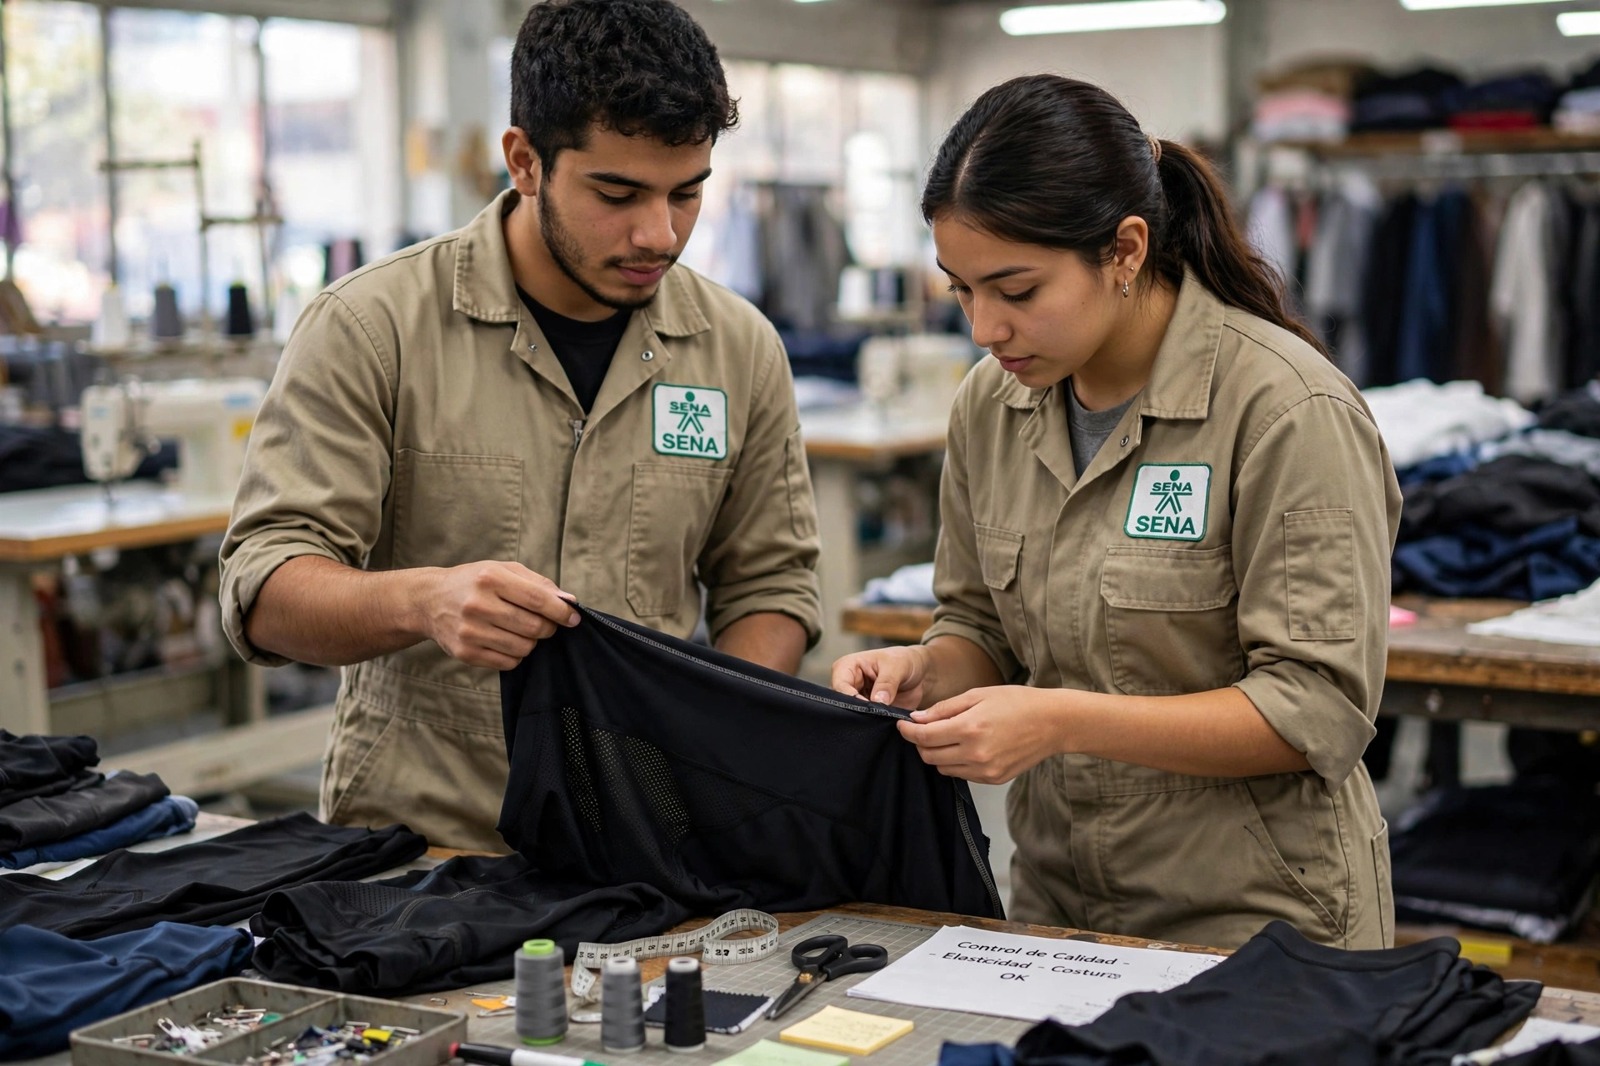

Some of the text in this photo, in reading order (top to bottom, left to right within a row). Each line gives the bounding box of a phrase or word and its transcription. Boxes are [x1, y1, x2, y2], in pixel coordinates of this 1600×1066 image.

[670, 401, 711, 414] SENA
[662, 433, 719, 454] SENA
[1151, 482, 1193, 492] SENA
[1135, 515, 1196, 535] SENA
[957, 941, 1022, 955] Control
[1025, 949, 1047, 958] de
[1053, 952, 1118, 966] Calidad
[1000, 972, 1030, 982] OK
